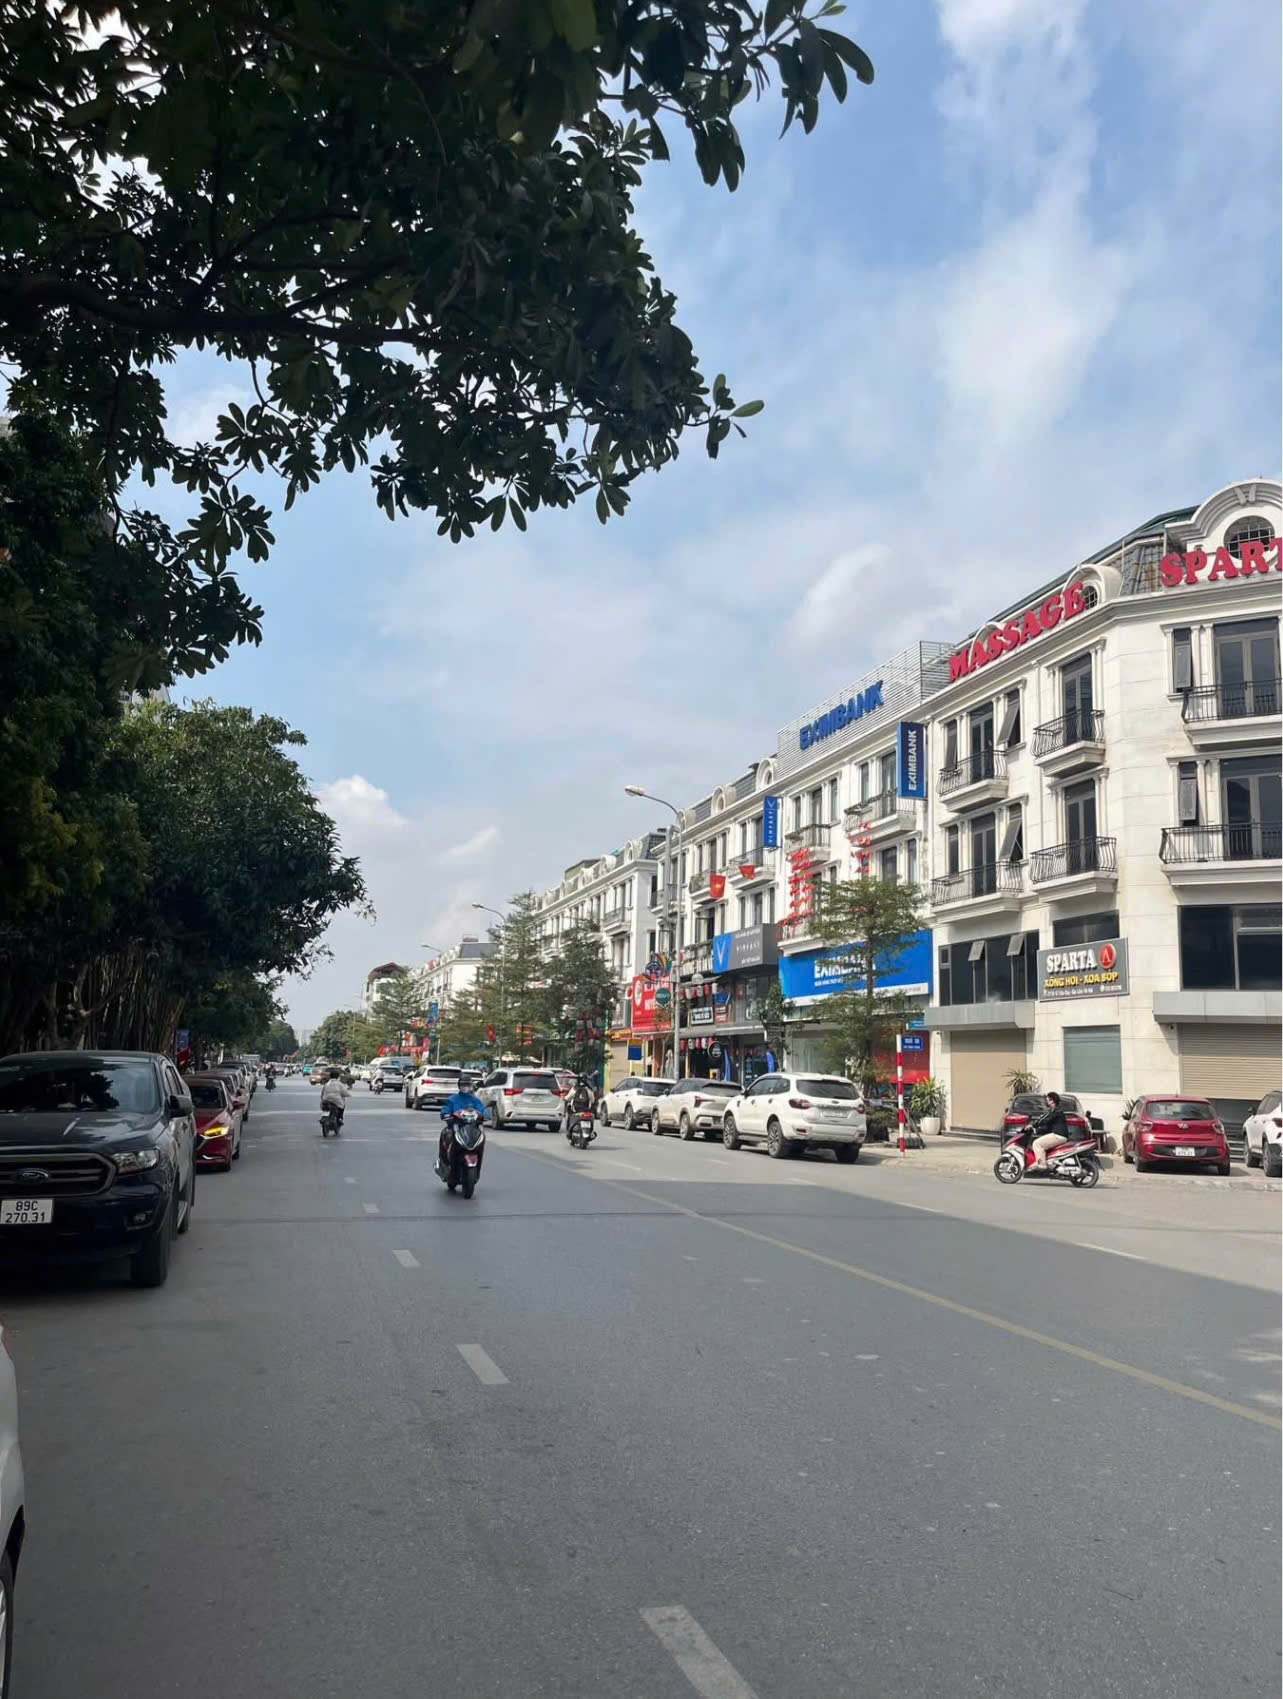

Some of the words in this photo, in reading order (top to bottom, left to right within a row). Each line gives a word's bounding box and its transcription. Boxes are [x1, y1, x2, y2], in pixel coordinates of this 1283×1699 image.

[949, 581, 1087, 683] MASSAGE
[800, 680, 884, 751] EXIMBANK
[908, 730, 917, 790] EXIMBANK
[1046, 949, 1097, 973] SPARTA
[5, 1212, 46, 1223] 270.31
[16, 1201, 38, 1211] 89C
